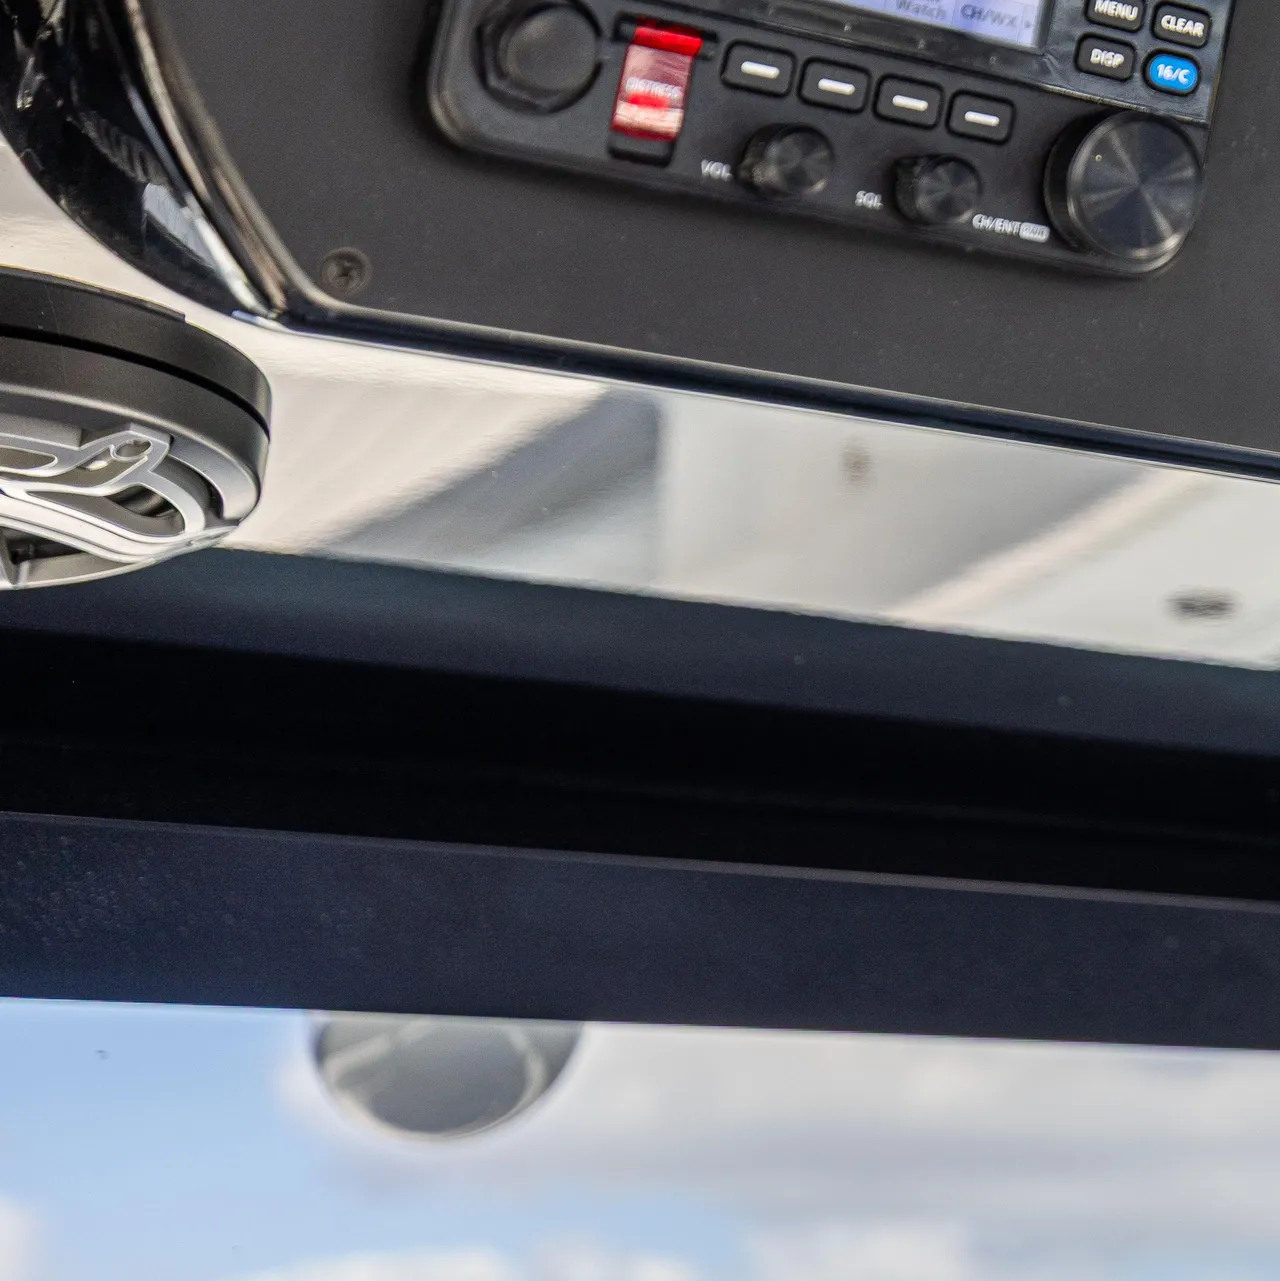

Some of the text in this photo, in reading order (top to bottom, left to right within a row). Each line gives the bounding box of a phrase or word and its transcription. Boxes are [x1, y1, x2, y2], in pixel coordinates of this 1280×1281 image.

[1160, 14, 1205, 38] CLEAR
[1089, 47, 1125, 69] DISP
[1156, 61, 1191, 85] 16/C
[700, 159, 733, 182] VOL
[854, 189, 884, 211] SQL
